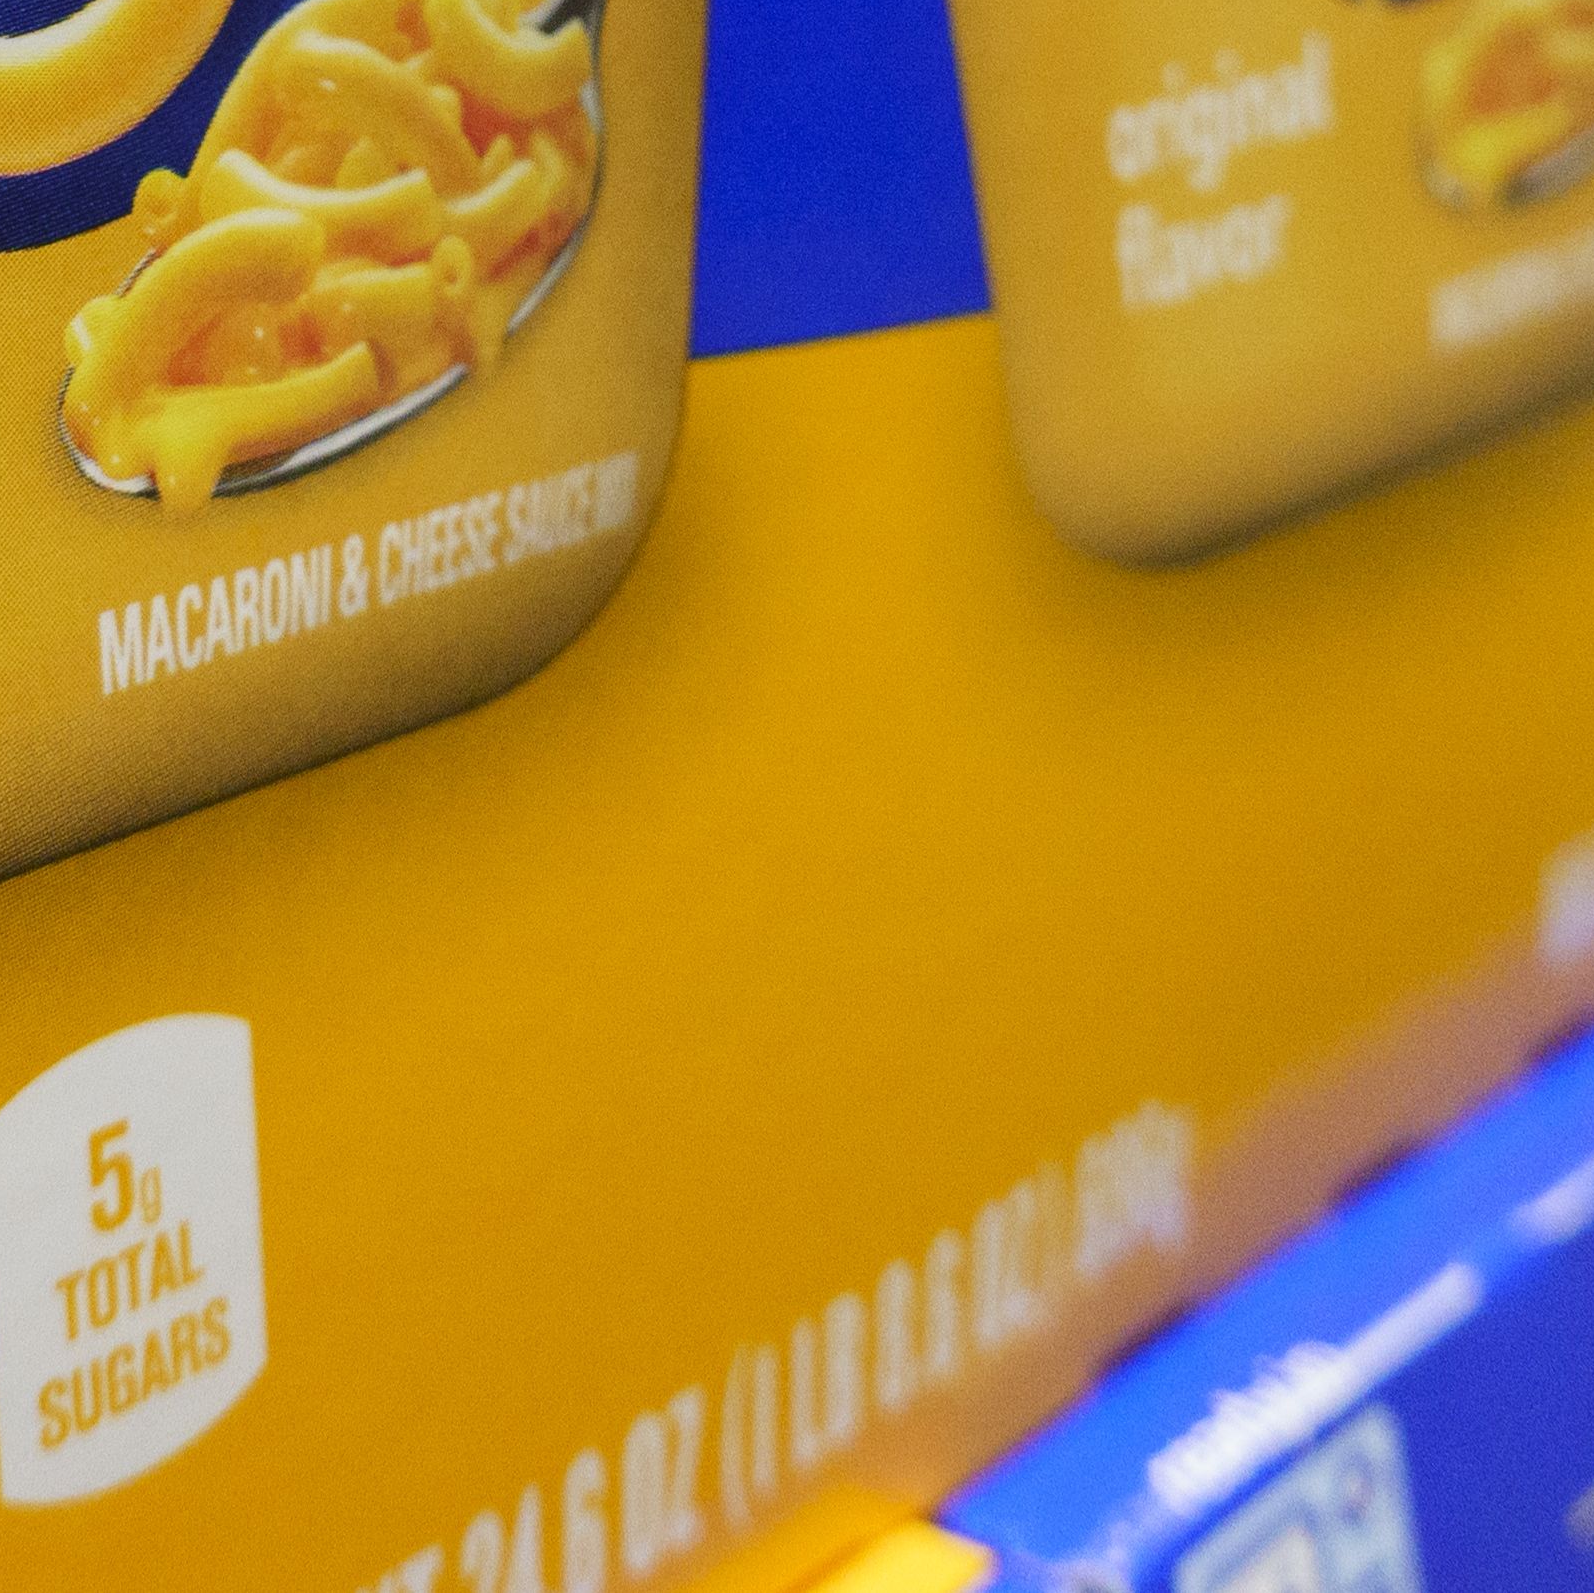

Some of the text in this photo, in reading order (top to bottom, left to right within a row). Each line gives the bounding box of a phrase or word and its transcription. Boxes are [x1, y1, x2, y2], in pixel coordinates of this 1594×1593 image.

[97, 542, 333, 695] MACARONI
[338, 533, 368, 619] &
[378, 491, 505, 605] CHEESE
[89, 1119, 163, 1232] 5g
[56, 1220, 205, 1344] TOTAL
[38, 1298, 231, 1452] SUGARS
